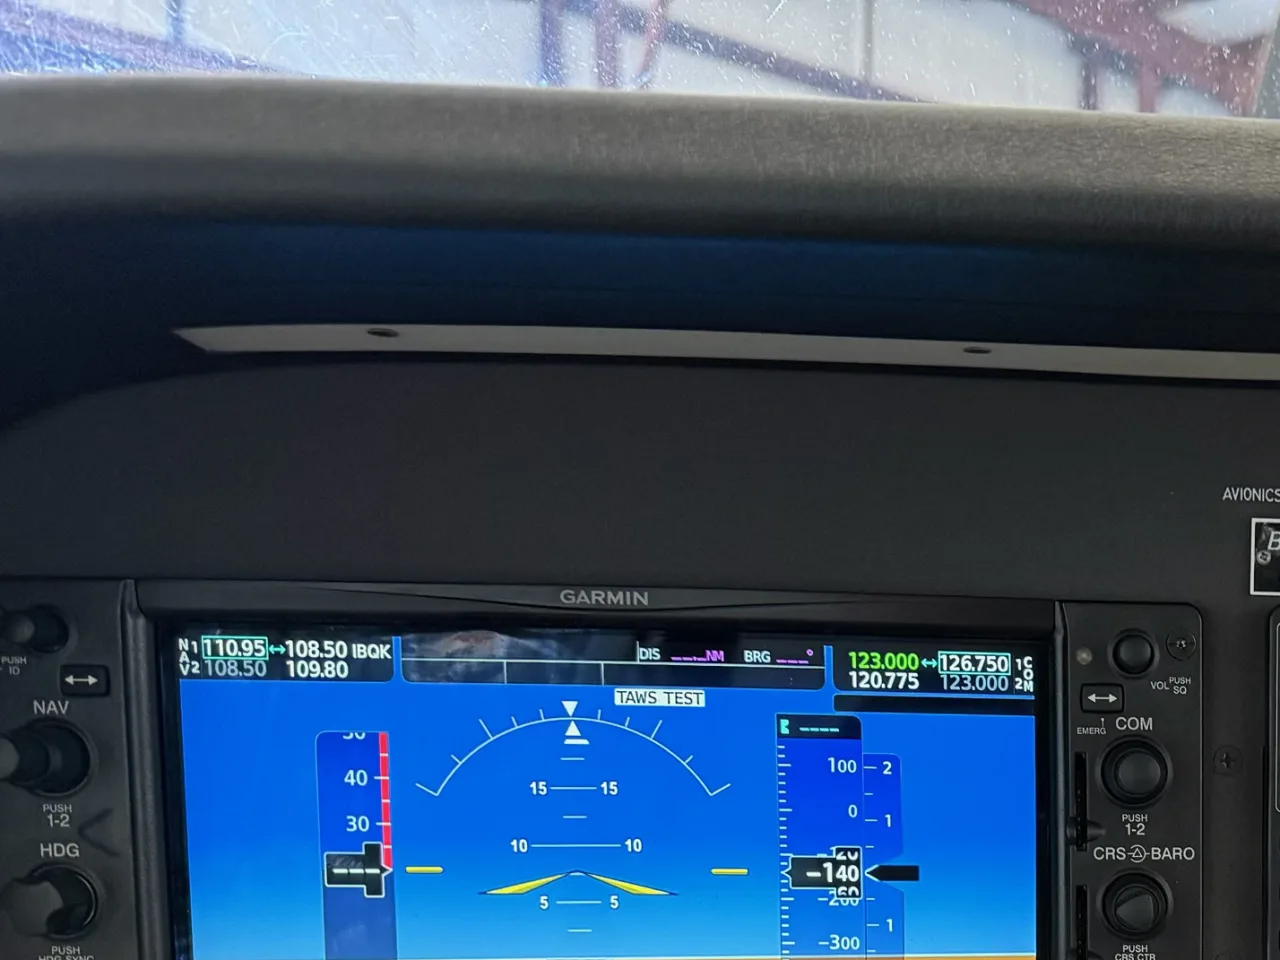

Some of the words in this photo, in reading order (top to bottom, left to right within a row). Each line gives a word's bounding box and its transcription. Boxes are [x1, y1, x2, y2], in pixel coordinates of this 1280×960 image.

[560, 589, 648, 606] GARMIN
[202, 638, 266, 657] 110.95
[285, 640, 348, 660] 108.50
[352, 642, 391, 660] IBQK
[205, 660, 267, 677] 108.50
[286, 661, 349, 679] 109.80
[848, 652, 920, 670] 123.000
[940, 654, 1009, 673] 126.750
[848, 671, 920, 691] 120.775
[940, 674, 1009, 692] 123.000
[617, 690, 657, 706] TAWS
[664, 691, 704, 706] TEST
[33, 700, 69, 715] NAV
[1115, 717, 1153, 731] COM
[40, 843, 80, 858] HDG
[1093, 846, 1126, 861] CRS
[1151, 846, 1196, 861] BARO
